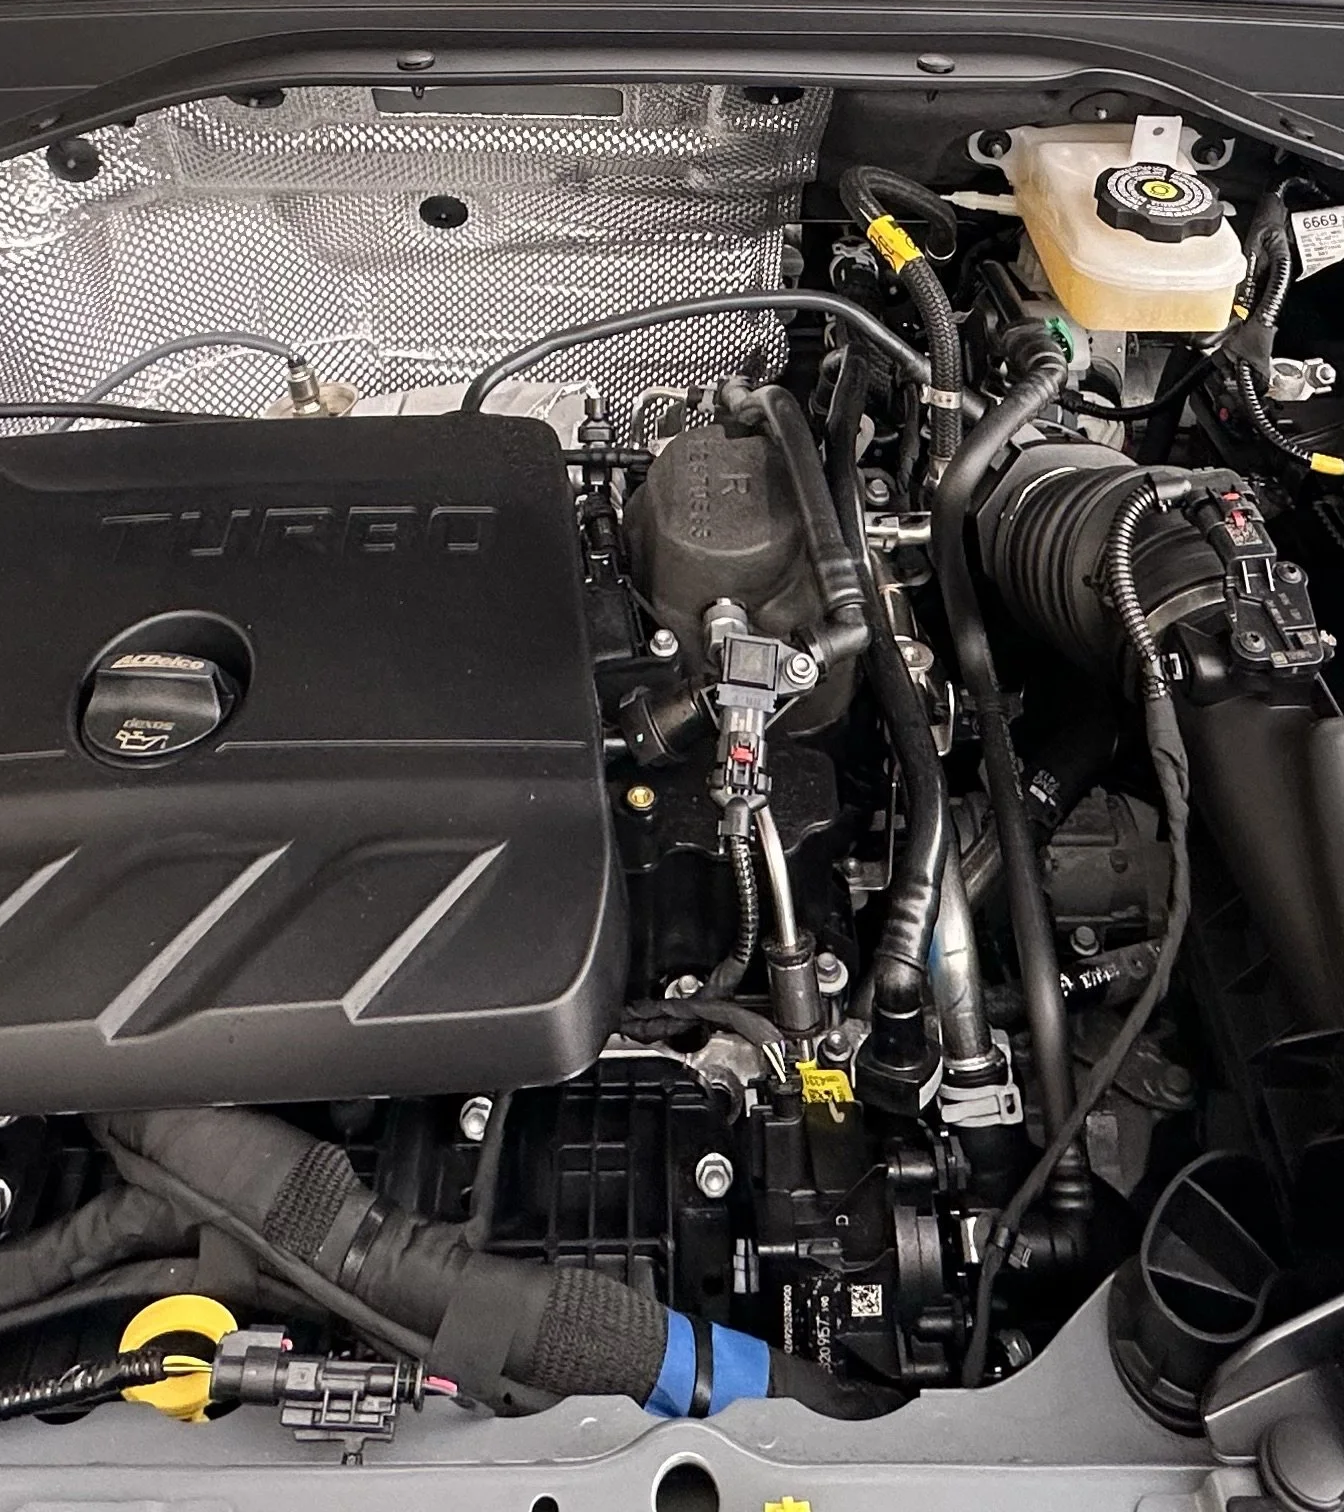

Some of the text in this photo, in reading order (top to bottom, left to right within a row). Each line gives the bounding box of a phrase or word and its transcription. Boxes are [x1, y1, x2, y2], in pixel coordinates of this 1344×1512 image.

[1303, 213, 1338, 229] 6669
[100, 505, 499, 560] TURBO
[111, 654, 205, 669] ACDelco
[123, 718, 175, 731] dexos
